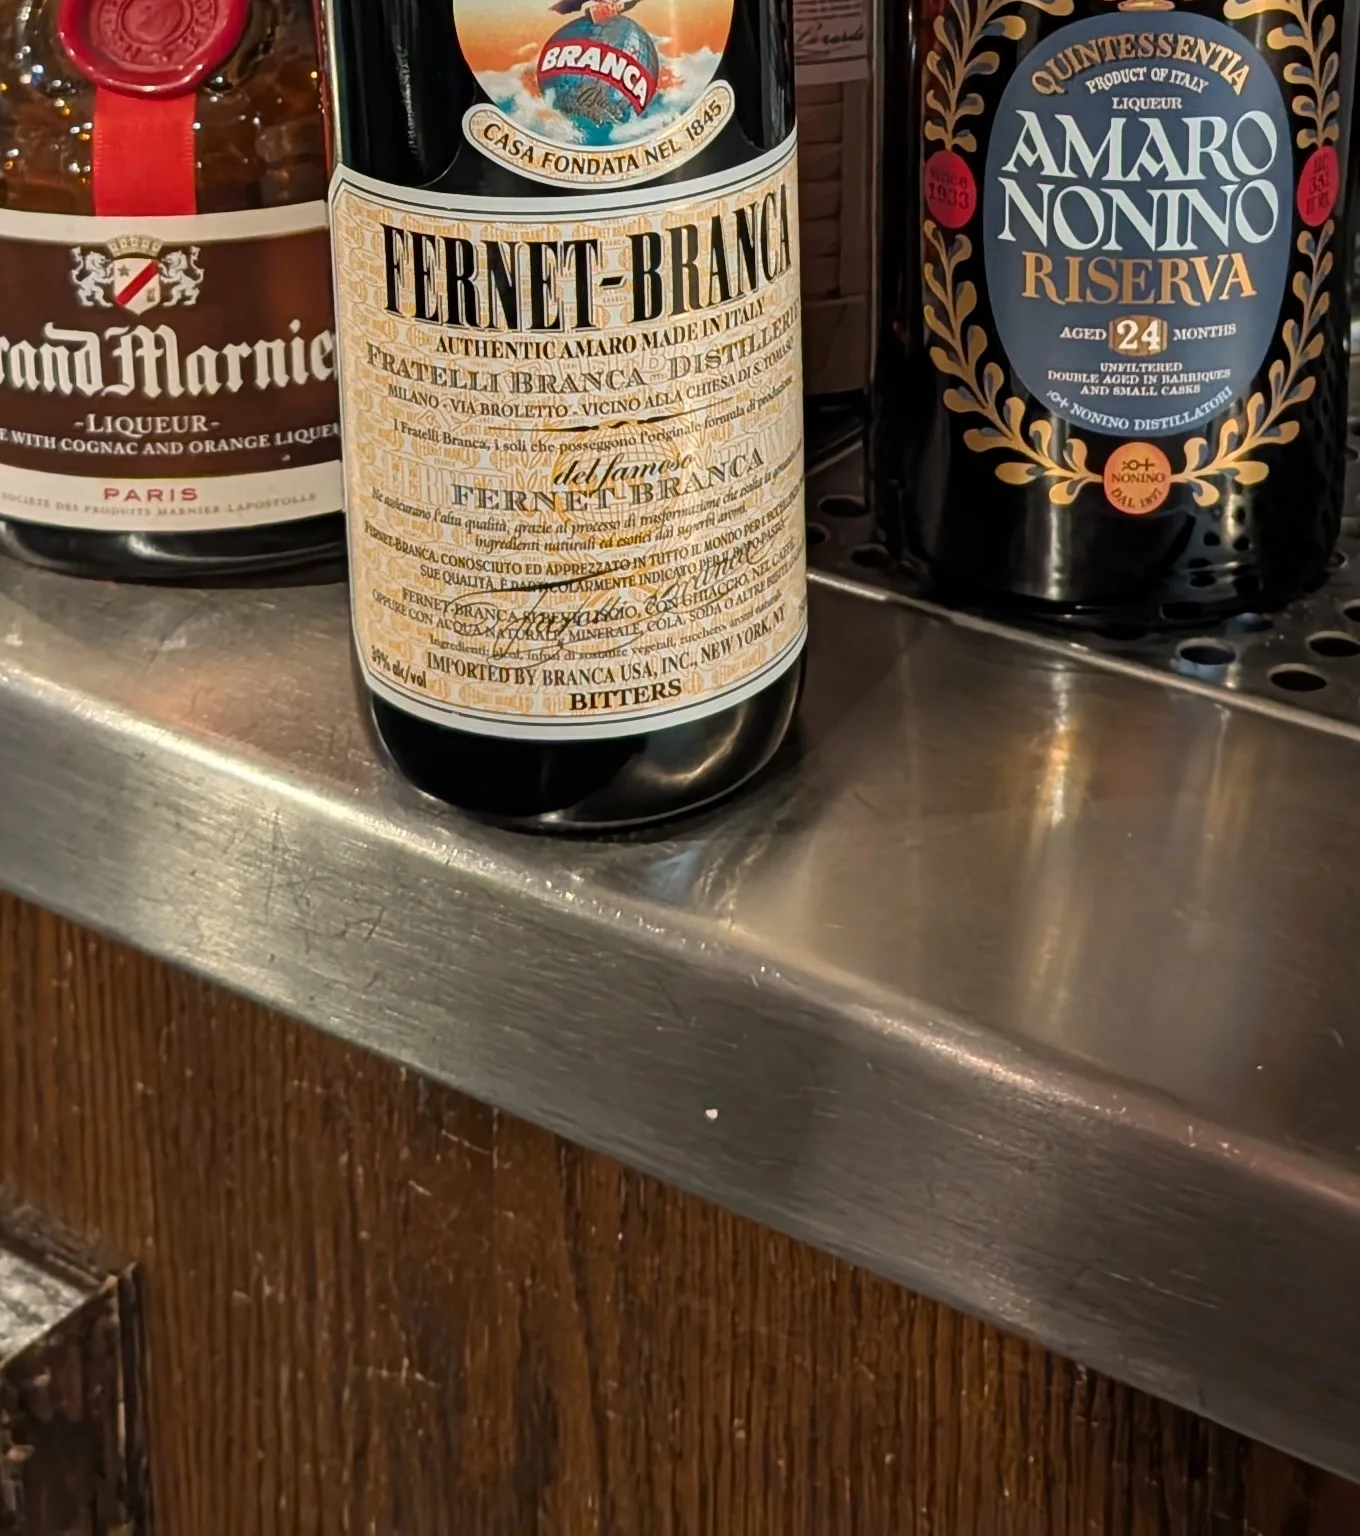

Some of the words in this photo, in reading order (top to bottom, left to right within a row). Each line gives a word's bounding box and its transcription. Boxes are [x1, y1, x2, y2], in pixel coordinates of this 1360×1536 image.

[541, 43, 649, 107] BRANCA
[1031, 32, 1251, 96] QUINTESSENTIA
[1085, 66, 1148, 95] PRODUCT
[1151, 67, 1170, 82] OF
[1170, 69, 1210, 95] ITALY
[1112, 96, 1183, 112] LIQUEUR
[484, 122, 535, 164] CASA
[541, 151, 641, 176] FONDATA
[644, 139, 682, 166] NEL
[685, 98, 723, 143] 1845
[1001, 109, 1279, 183] AMARO
[997, 175, 1280, 252] NONINO
[379, 183, 793, 333] FERNET-BRANCA
[1021, 250, 1258, 307] RISERVA
[436, 335, 557, 360] AUTHENTIC
[560, 334, 637, 359] AMARO
[641, 321, 699, 351] MADE
[702, 315, 722, 337] IN
[725, 296, 765, 330] ITALY
[1059, 325, 1107, 341] AGED
[1116, 319, 1161, 351] 24
[1172, 322, 1238, 341] MONTHS
[366, 341, 499, 393] FRATELLI
[510, 367, 648, 394] BRANCA
[1048, 369, 1100, 384] DOUBLE
[1103, 373, 1140, 385] AGED
[1143, 373, 1158, 385] IN
[1161, 368, 1232, 385] BARRIQUES
[1100, 361, 1183, 373] UNFILTERED
[388, 384, 440, 409] MILANO
[450, 398, 477, 415] VIA
[480, 403, 569, 418] BROLETTO
[581, 398, 641, 417] VICINO
[644, 390, 684, 410] ALLA
[686, 373, 740, 400] CHIESA
[737, 366, 751, 383] DI
[1069, 403, 1130, 431] NONINO
[1134, 386, 1234, 432] DISTILLATORI
[1080, 384, 1110, 396] AND
[1113, 385, 1158, 397] SMALL
[1161, 384, 1201, 396] CASKS
[11, 429, 56, 450] WITH
[61, 437, 139, 456] COGNAC
[142, 440, 184, 456] AND
[189, 433, 270, 454] ORANGE
[401, 421, 440, 444] Fratelli
[442, 432, 490, 452] Branca,
[494, 439, 500, 451] i
[503, 440, 527, 452] soli
[530, 439, 556, 453] che
[559, 435, 637, 455] posseggono
[704, 406, 745, 429] formula
[746, 398, 758, 414] di
[103, 487, 198, 502] PARIS
[553, 457, 601, 485] del
[588, 451, 692, 499] famoso
[1111, 472, 1166, 484] NONINO
[1111, 487, 1136, 509] DAL
[475, 534, 541, 555] ingredienti
[544, 537, 596, 552] naturali
[514, 522, 552, 539] grazie
[555, 517, 569, 534] al
[571, 521, 621, 540] processo
[624, 513, 637, 529] di
[440, 552, 523, 575] CONOSCIUTO
[525, 563, 543, 576] ED
[545, 559, 630, 576] APPREZZATO
[633, 555, 647, 569] IN
[649, 546, 689, 565] TUTTO
[691, 543, 702, 556] IL
[704, 527, 743, 553] MONDO
[420, 564, 441, 581] SUE
[639, 562, 697, 585] INDICATO
[372, 588, 407, 616] OPPURE
[408, 608, 433, 625] CON
[435, 617, 481, 635] ACQUA
[569, 623, 643, 642] MINERALE,
[646, 614, 687, 632] COLA,
[689, 601, 723, 622] SODA
[724, 597, 734, 610] O
[401, 586, 520, 624] FERNET-BRANCA
[427, 651, 511, 684] IMPORTED
[514, 667, 537, 686] BY
[542, 666, 616, 687] BRANCA
[620, 659, 658, 683] USA,
[661, 651, 698, 675] INC.,
[700, 634, 734, 664] NEW
[734, 615, 772, 648] YORK,
[429, 634, 490, 657] Ingredienti:
[568, 677, 682, 711] BITTERS
